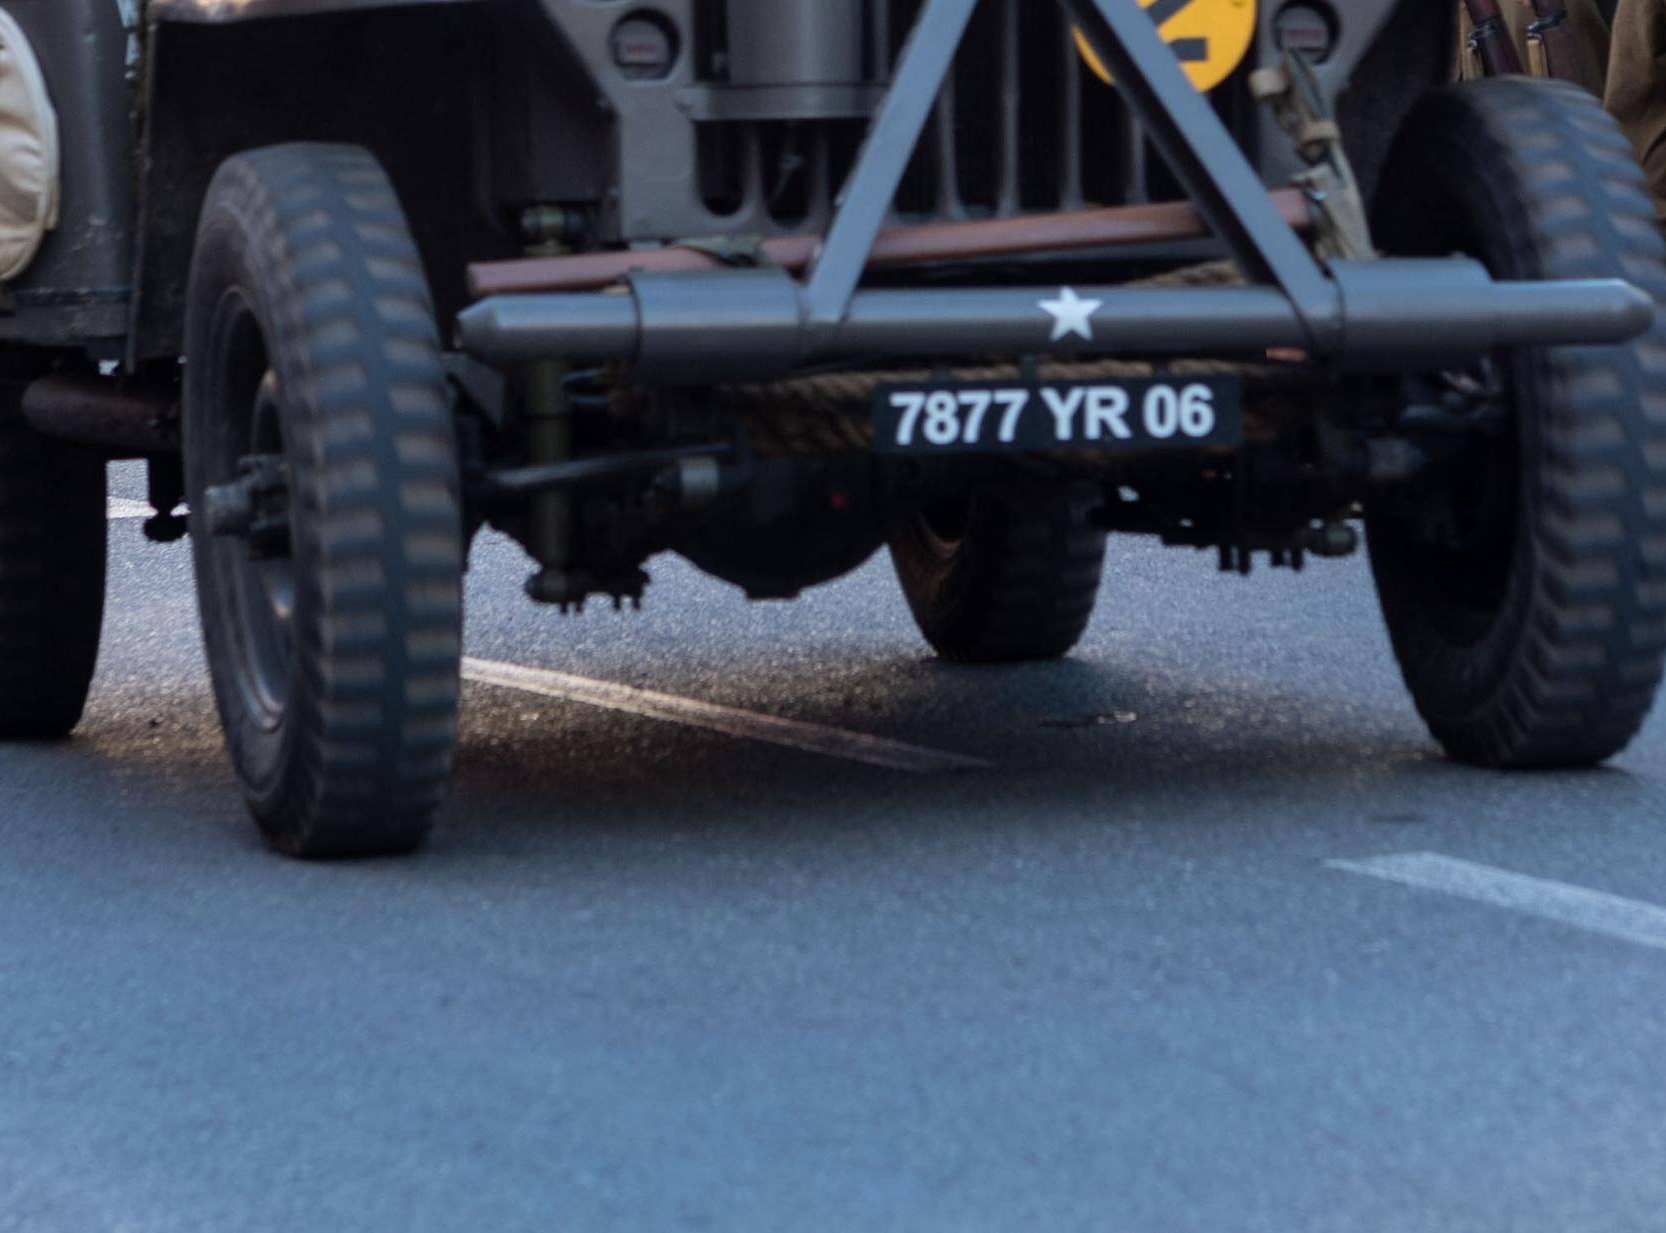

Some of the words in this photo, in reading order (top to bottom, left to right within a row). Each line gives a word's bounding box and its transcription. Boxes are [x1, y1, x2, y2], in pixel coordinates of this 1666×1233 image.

[889, 388, 1029, 446] 7877
[1040, 385, 1133, 442] YR
[1142, 382, 1216, 439] 06
